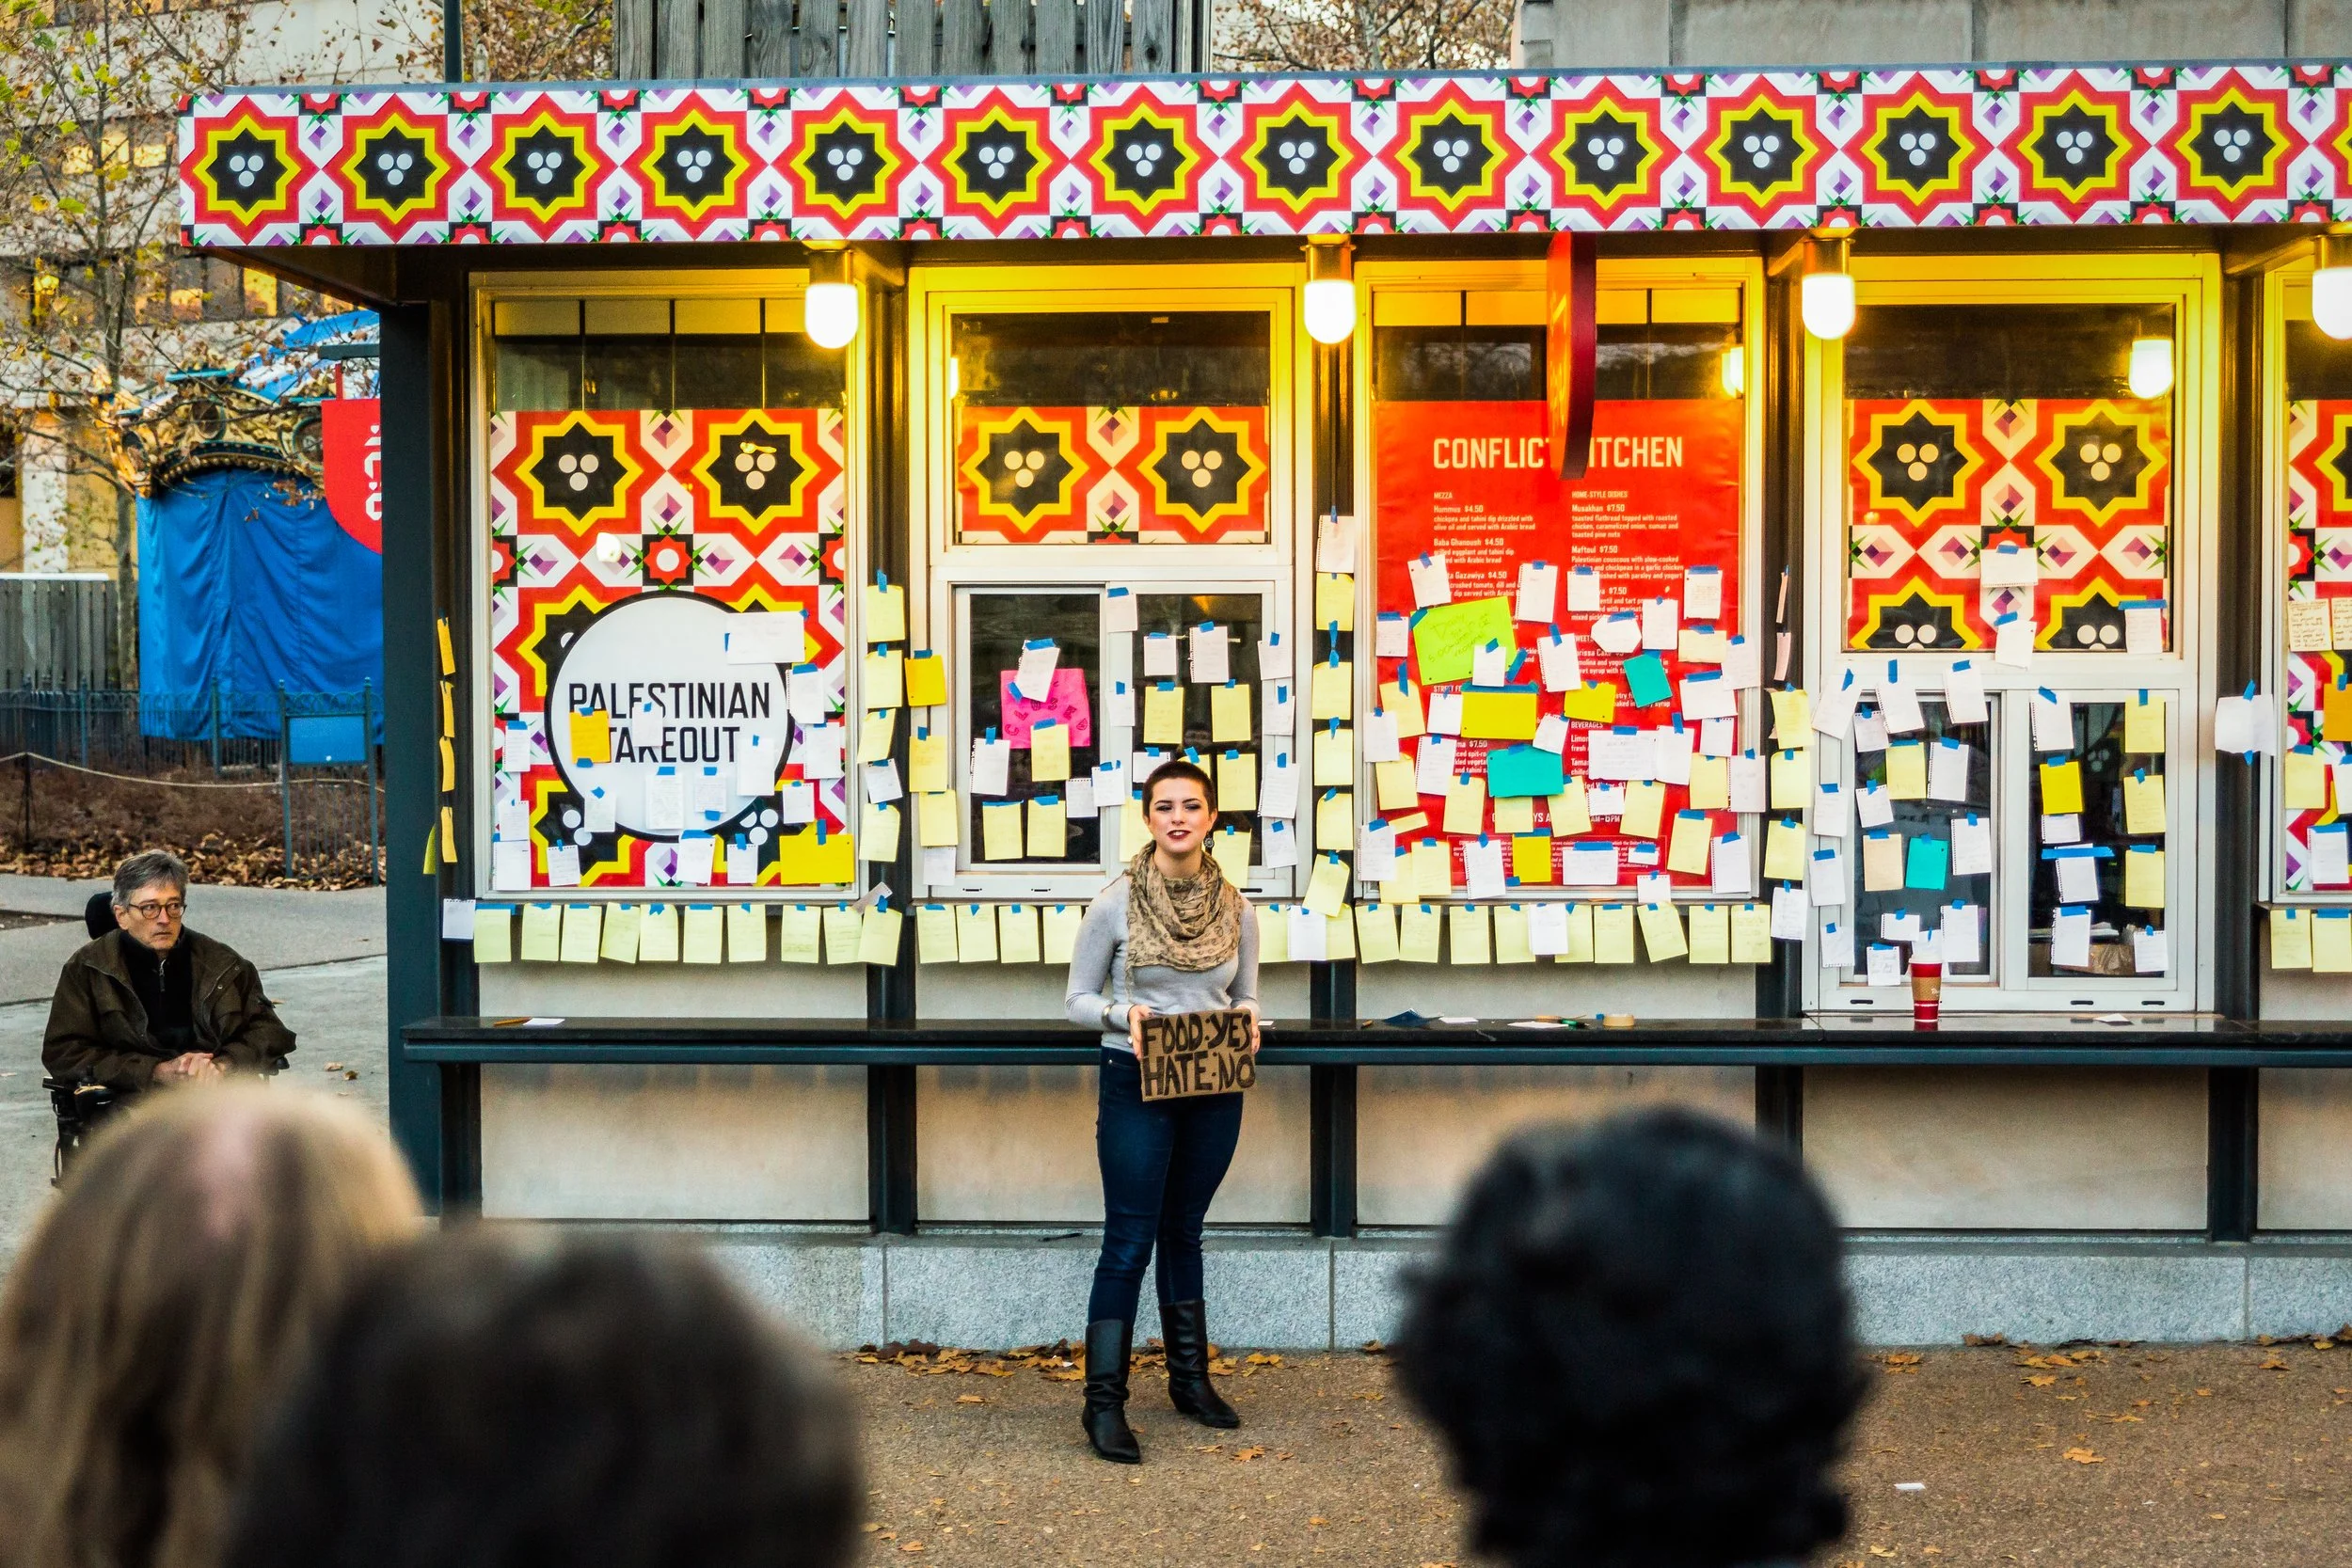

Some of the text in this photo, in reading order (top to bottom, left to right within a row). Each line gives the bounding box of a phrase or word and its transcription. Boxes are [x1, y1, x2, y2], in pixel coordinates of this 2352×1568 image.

[1433, 436, 1682, 468] CONFLIC ITCHEN
[1571, 504, 1625, 513] Musakhan $7.50
[1455, 571, 1485, 579] Gazawiya
[1488, 571, 1507, 579] $4.50
[569, 683, 770, 719] PALESTINIAN
